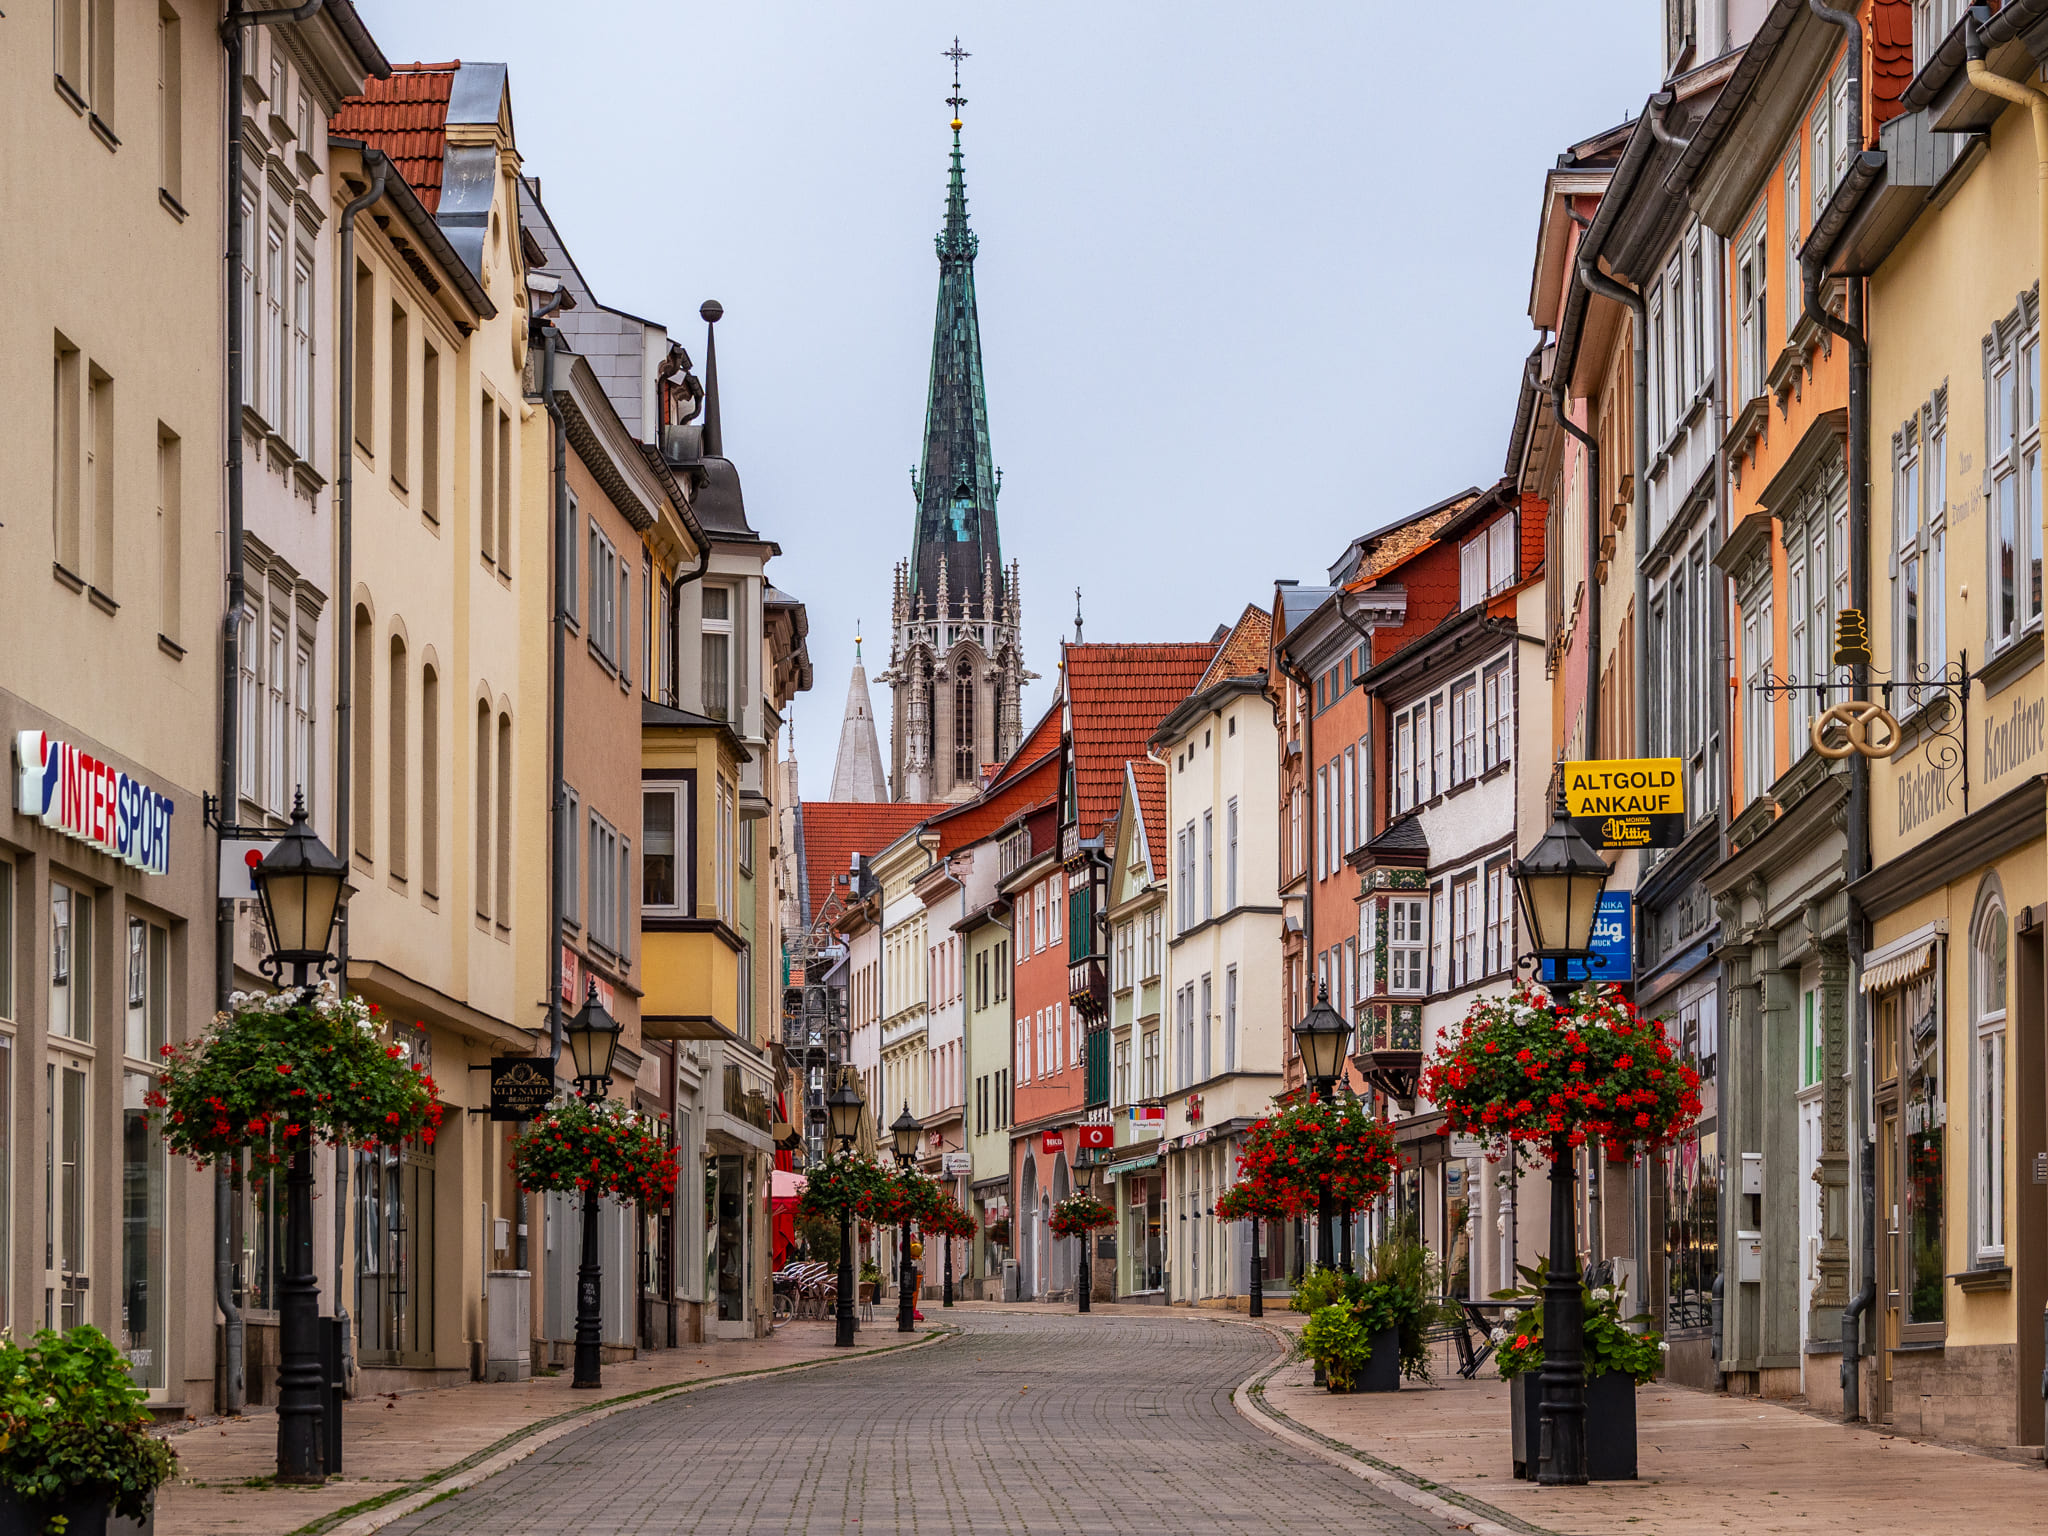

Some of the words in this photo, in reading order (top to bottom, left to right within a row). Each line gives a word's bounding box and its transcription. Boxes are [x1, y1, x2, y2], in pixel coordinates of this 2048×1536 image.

[1572, 771, 1675, 791] ALTGOLD
[1898, 744, 1946, 837] Bäckerei
[60, 740, 175, 876] INTERSPORT
[1580, 794, 1670, 814] ANKAUF
[1607, 817, 1652, 844] Wittig
[1590, 939, 1611, 947] MUCK
[519, 1087, 553, 1095] NAILS
